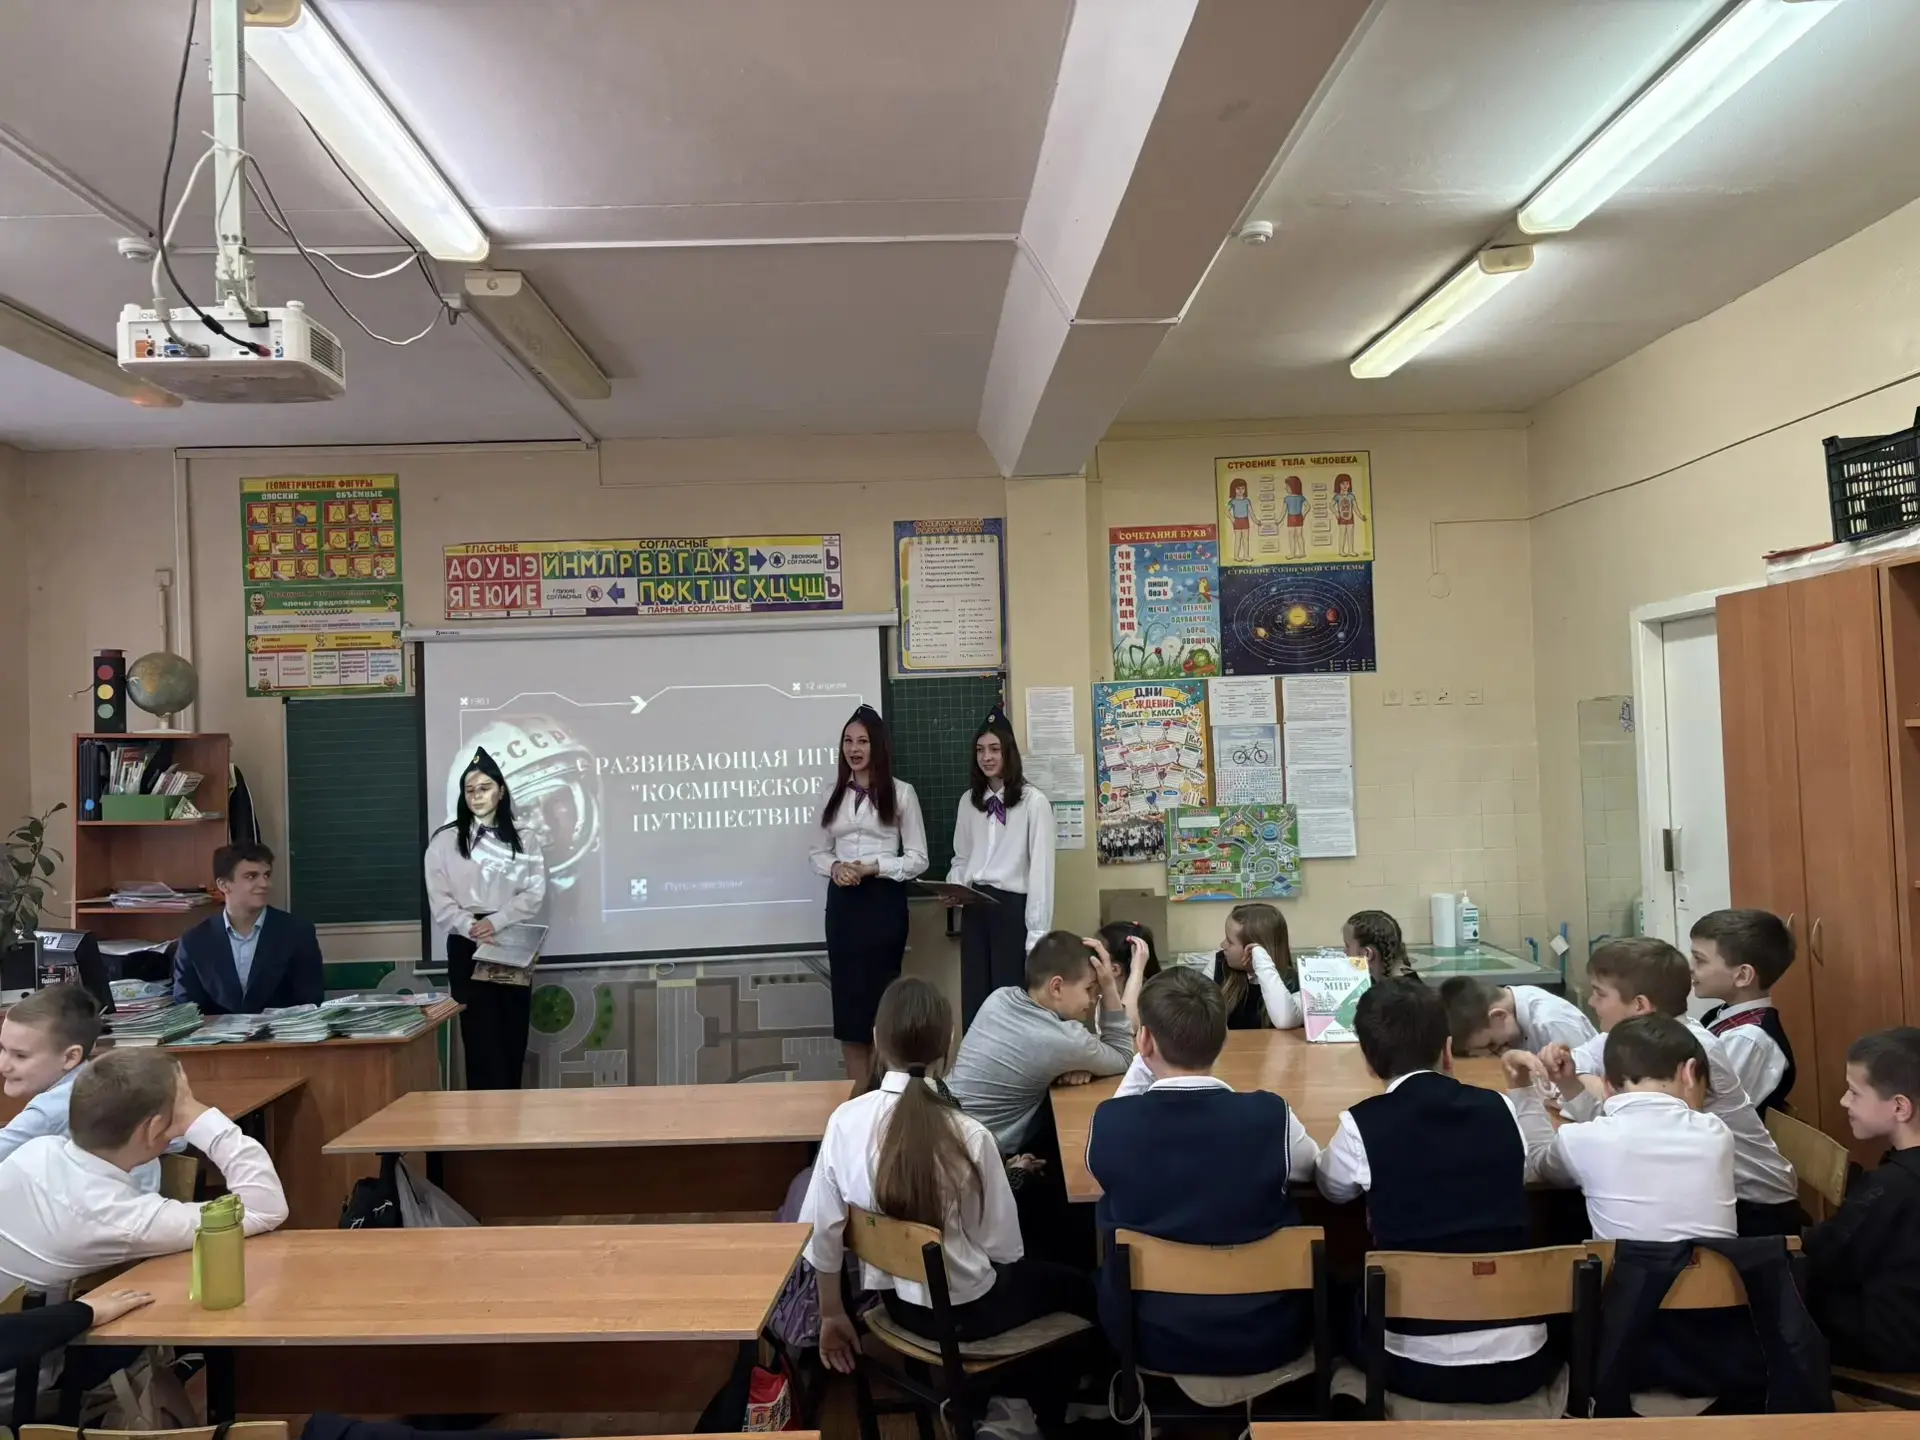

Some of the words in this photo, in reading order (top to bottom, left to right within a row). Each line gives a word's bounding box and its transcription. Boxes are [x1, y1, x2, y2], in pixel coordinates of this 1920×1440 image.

[1228, 459, 1276, 469] СТРОЕНИЕ
[1281, 458, 1305, 466] ТЕЛА
[1310, 456, 1358, 464] ЧЕЛОВЕКА
[1119, 531, 1177, 541] СОЧЕТАНИЯ
[1180, 530, 1206, 538] БУКВ
[465, 543, 519, 554] ГЛАСНЫЕ
[639, 539, 709, 549] СОГЛАСНЫЕ
[647, 605, 685, 614] ПАРНЫЕ
[687, 603, 742, 613] СОГЛАСНЫЕ
[1134, 686, 1163, 699] ДНИ
[1151, 708, 1182, 717] КЛАССА
[595, 749, 788, 775] РАЗВИВАЮЩАЯ
[632, 806, 816, 832] ПУТЕШЕСТВИЕ
